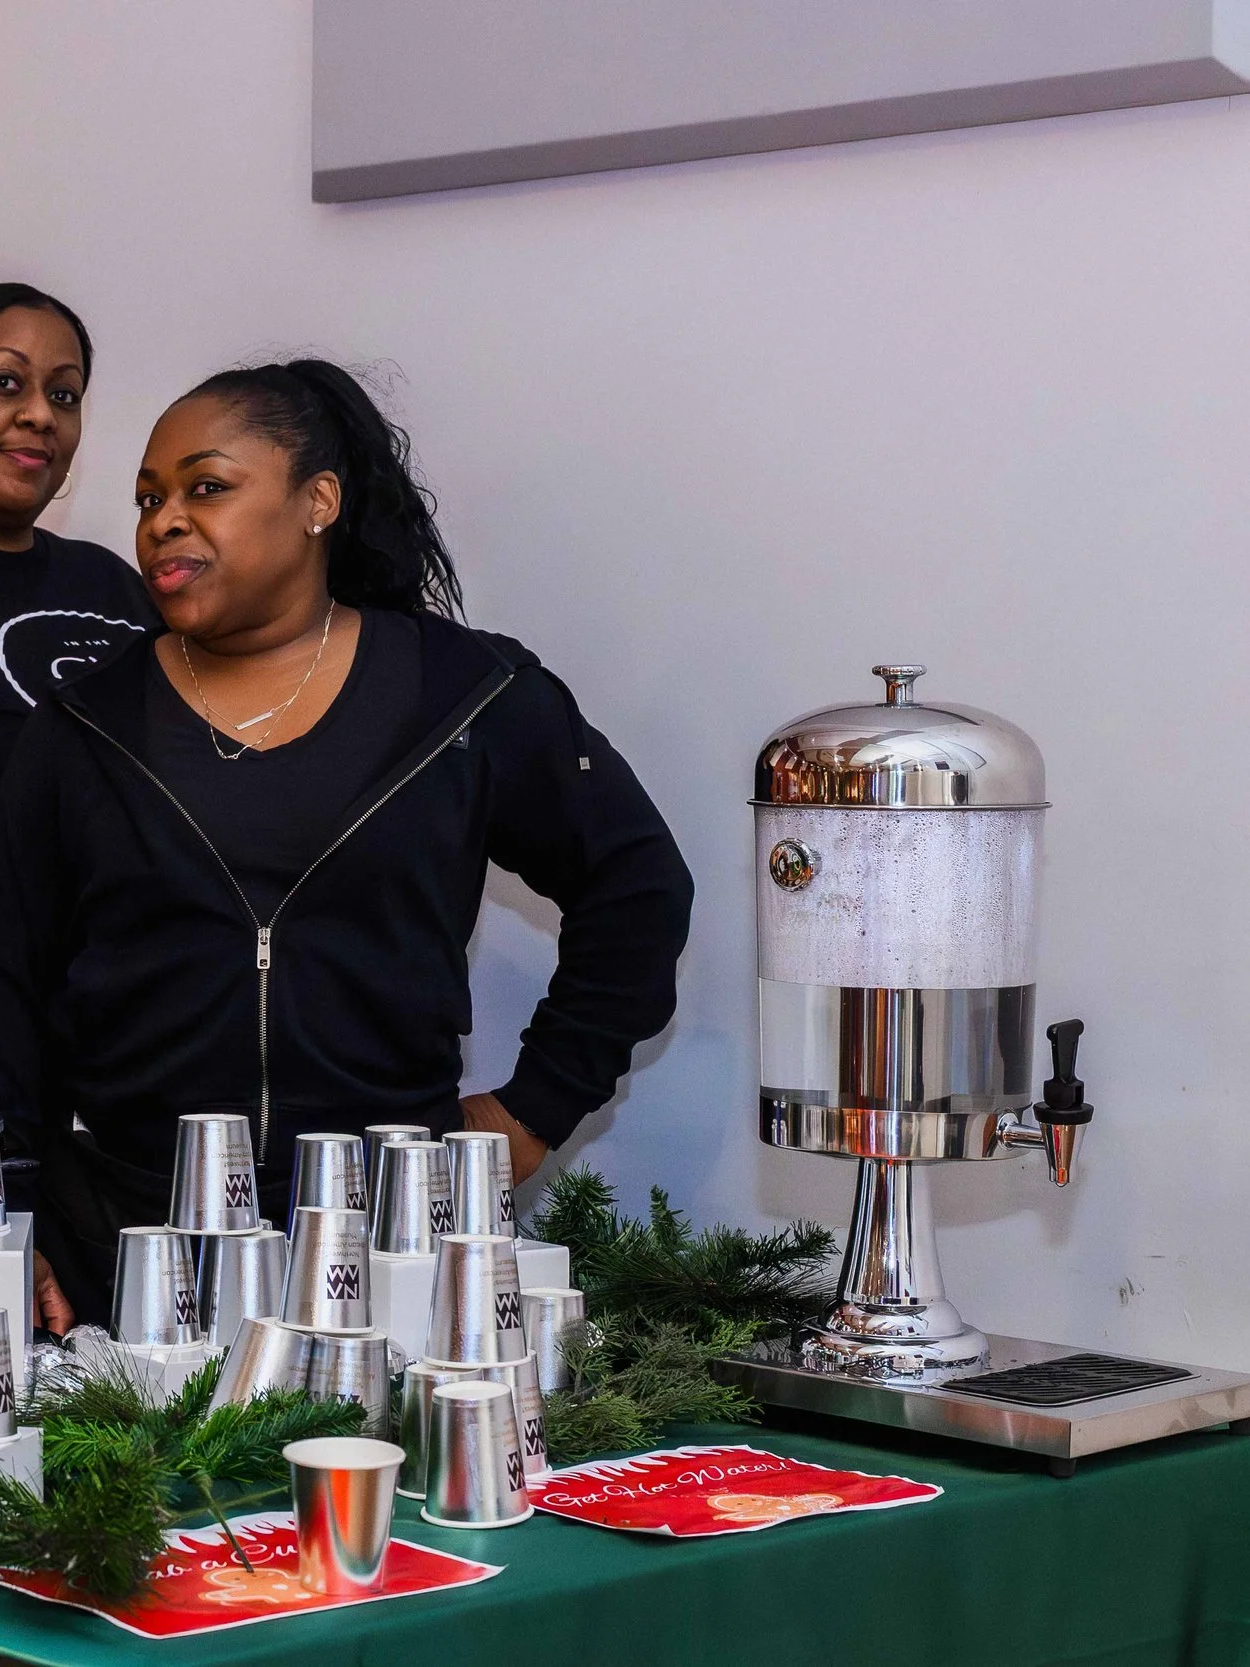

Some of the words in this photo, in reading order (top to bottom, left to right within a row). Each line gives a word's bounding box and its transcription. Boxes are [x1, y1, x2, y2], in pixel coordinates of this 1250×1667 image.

[543, 1493, 608, 1508] Get
[603, 1482, 677, 1499] Hot
[677, 1461, 792, 1486] Water!
[200, 1559, 228, 1571] a
[230, 1543, 299, 1565] Cu
